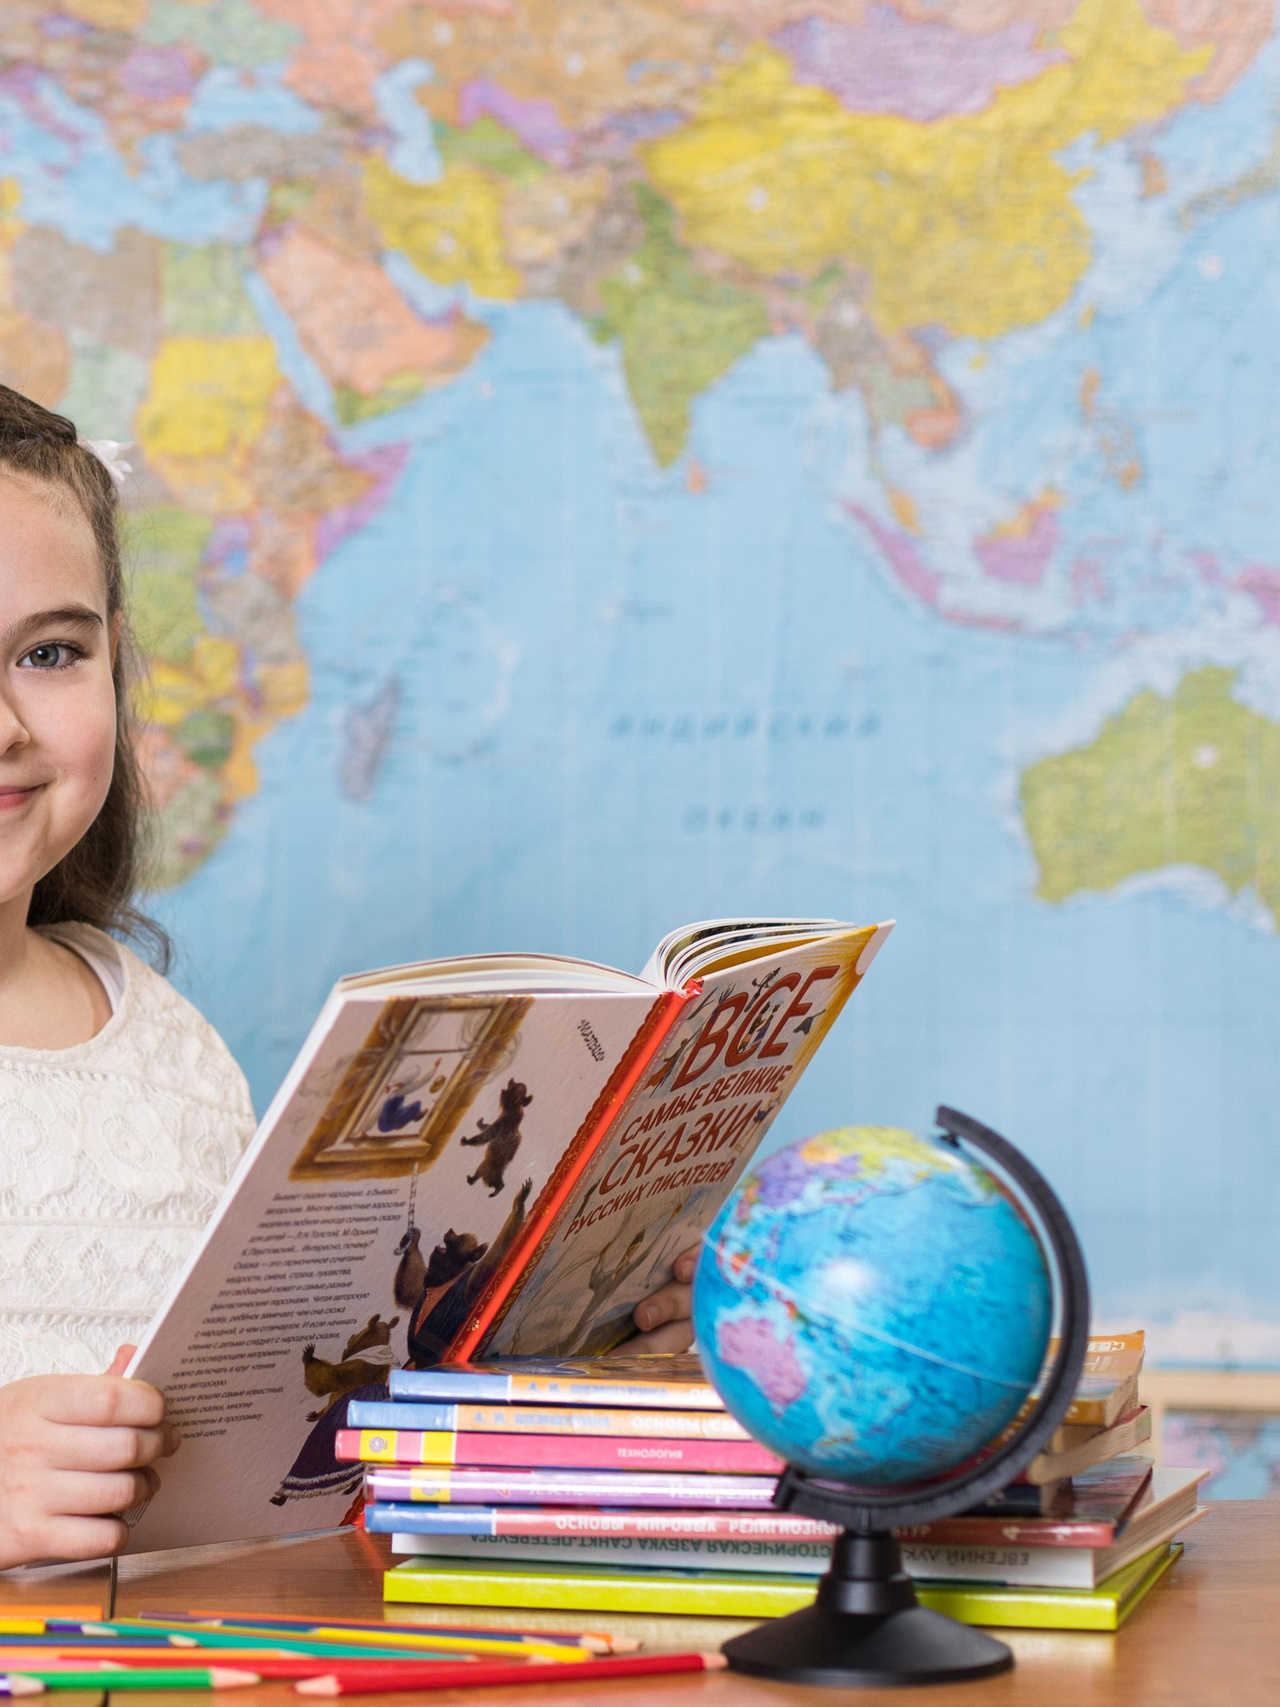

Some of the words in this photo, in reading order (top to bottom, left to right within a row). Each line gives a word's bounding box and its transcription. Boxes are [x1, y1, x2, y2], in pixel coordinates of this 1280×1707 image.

[671, 965, 840, 1093] ВСЕ
[620, 1081, 709, 1146] САМЫЕ
[710, 1064, 793, 1103] ВЕЛИКИЕ
[598, 1099, 762, 1196] СКАЗКИ
[562, 1181, 650, 1242] РУССКИХ
[646, 1157, 735, 1199] ПИСАТЕЛЕЙ
[631, 1417, 699, 1431] ОСНОВЫ
[617, 1447, 684, 1460] ТЕХНОЛОГИЯ
[554, 1516, 624, 1532] ОСНОВЫ
[636, 1518, 717, 1533] МИРОВЫХ
[639, 1538, 701, 1552] АЗБУКА
[707, 1540, 832, 1558] СТОРИЧЕСКАЯ
[946, 1551, 1030, 1566] ЕВГЕНИЙ
